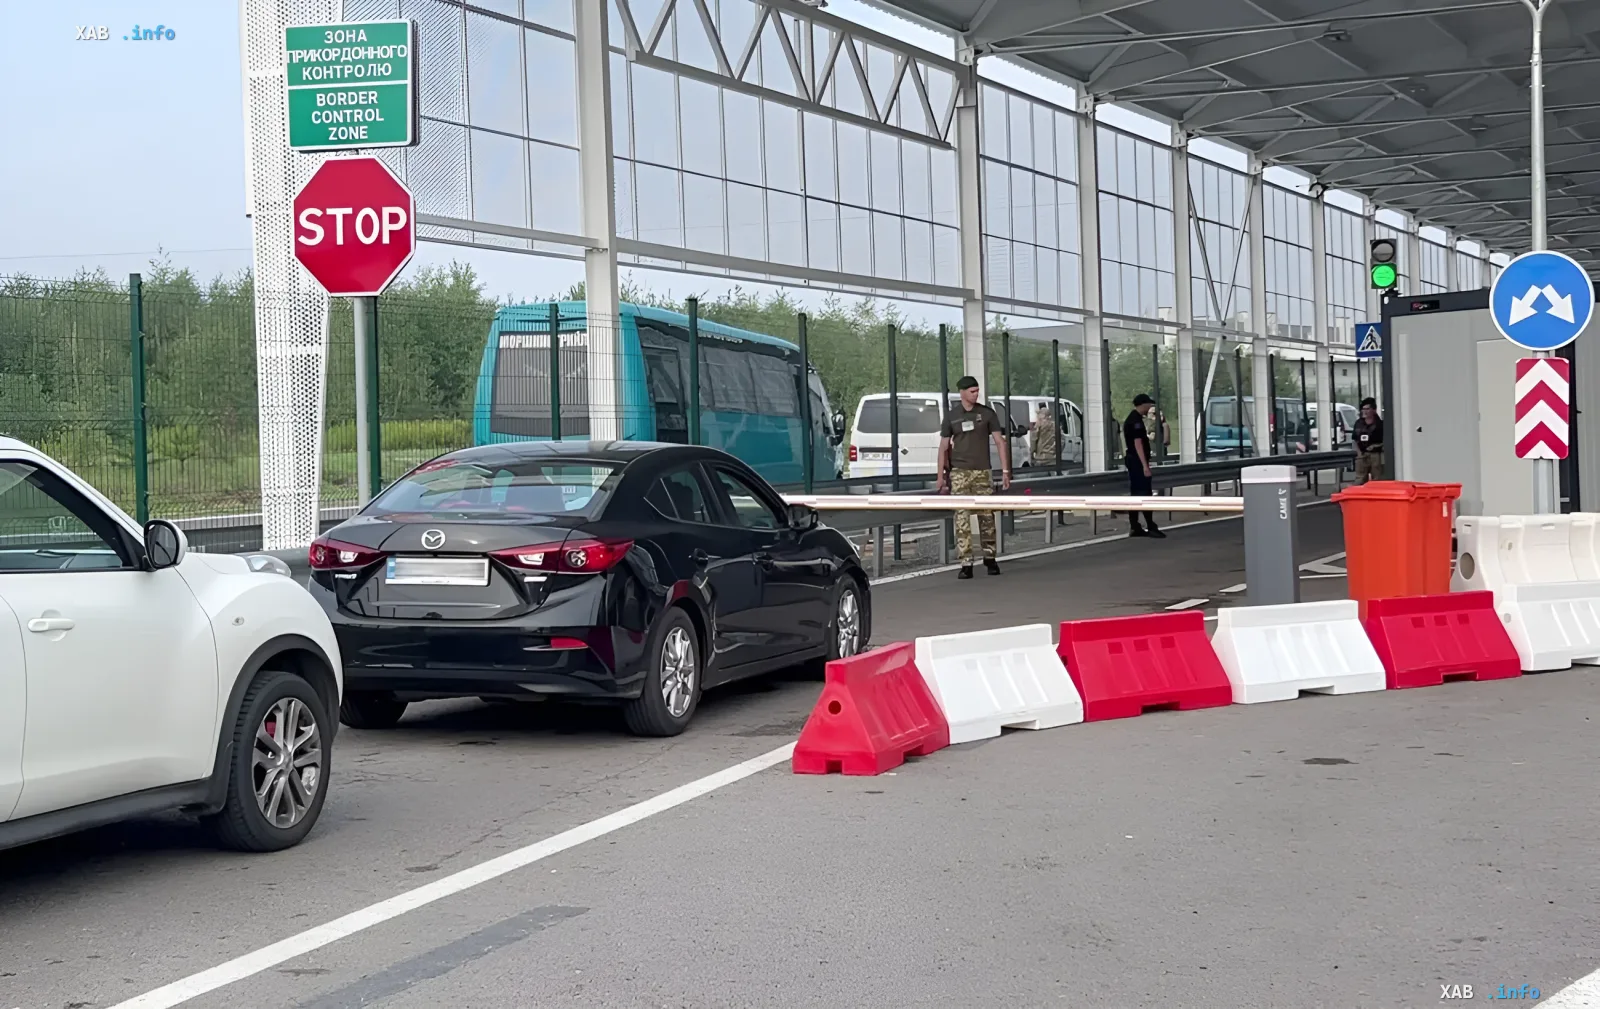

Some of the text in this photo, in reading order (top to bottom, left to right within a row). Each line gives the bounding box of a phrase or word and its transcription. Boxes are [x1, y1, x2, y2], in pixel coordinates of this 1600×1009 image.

[324, 29, 367, 44] ЗОНА
[286, 44, 407, 63] ПРИКОРДОННОГО
[302, 62, 392, 80] КОНТРОЛЮ
[316, 91, 378, 107] BORDER
[311, 108, 384, 124] CONTROL
[328, 126, 368, 140] ZONE
[298, 206, 407, 246] STOP
